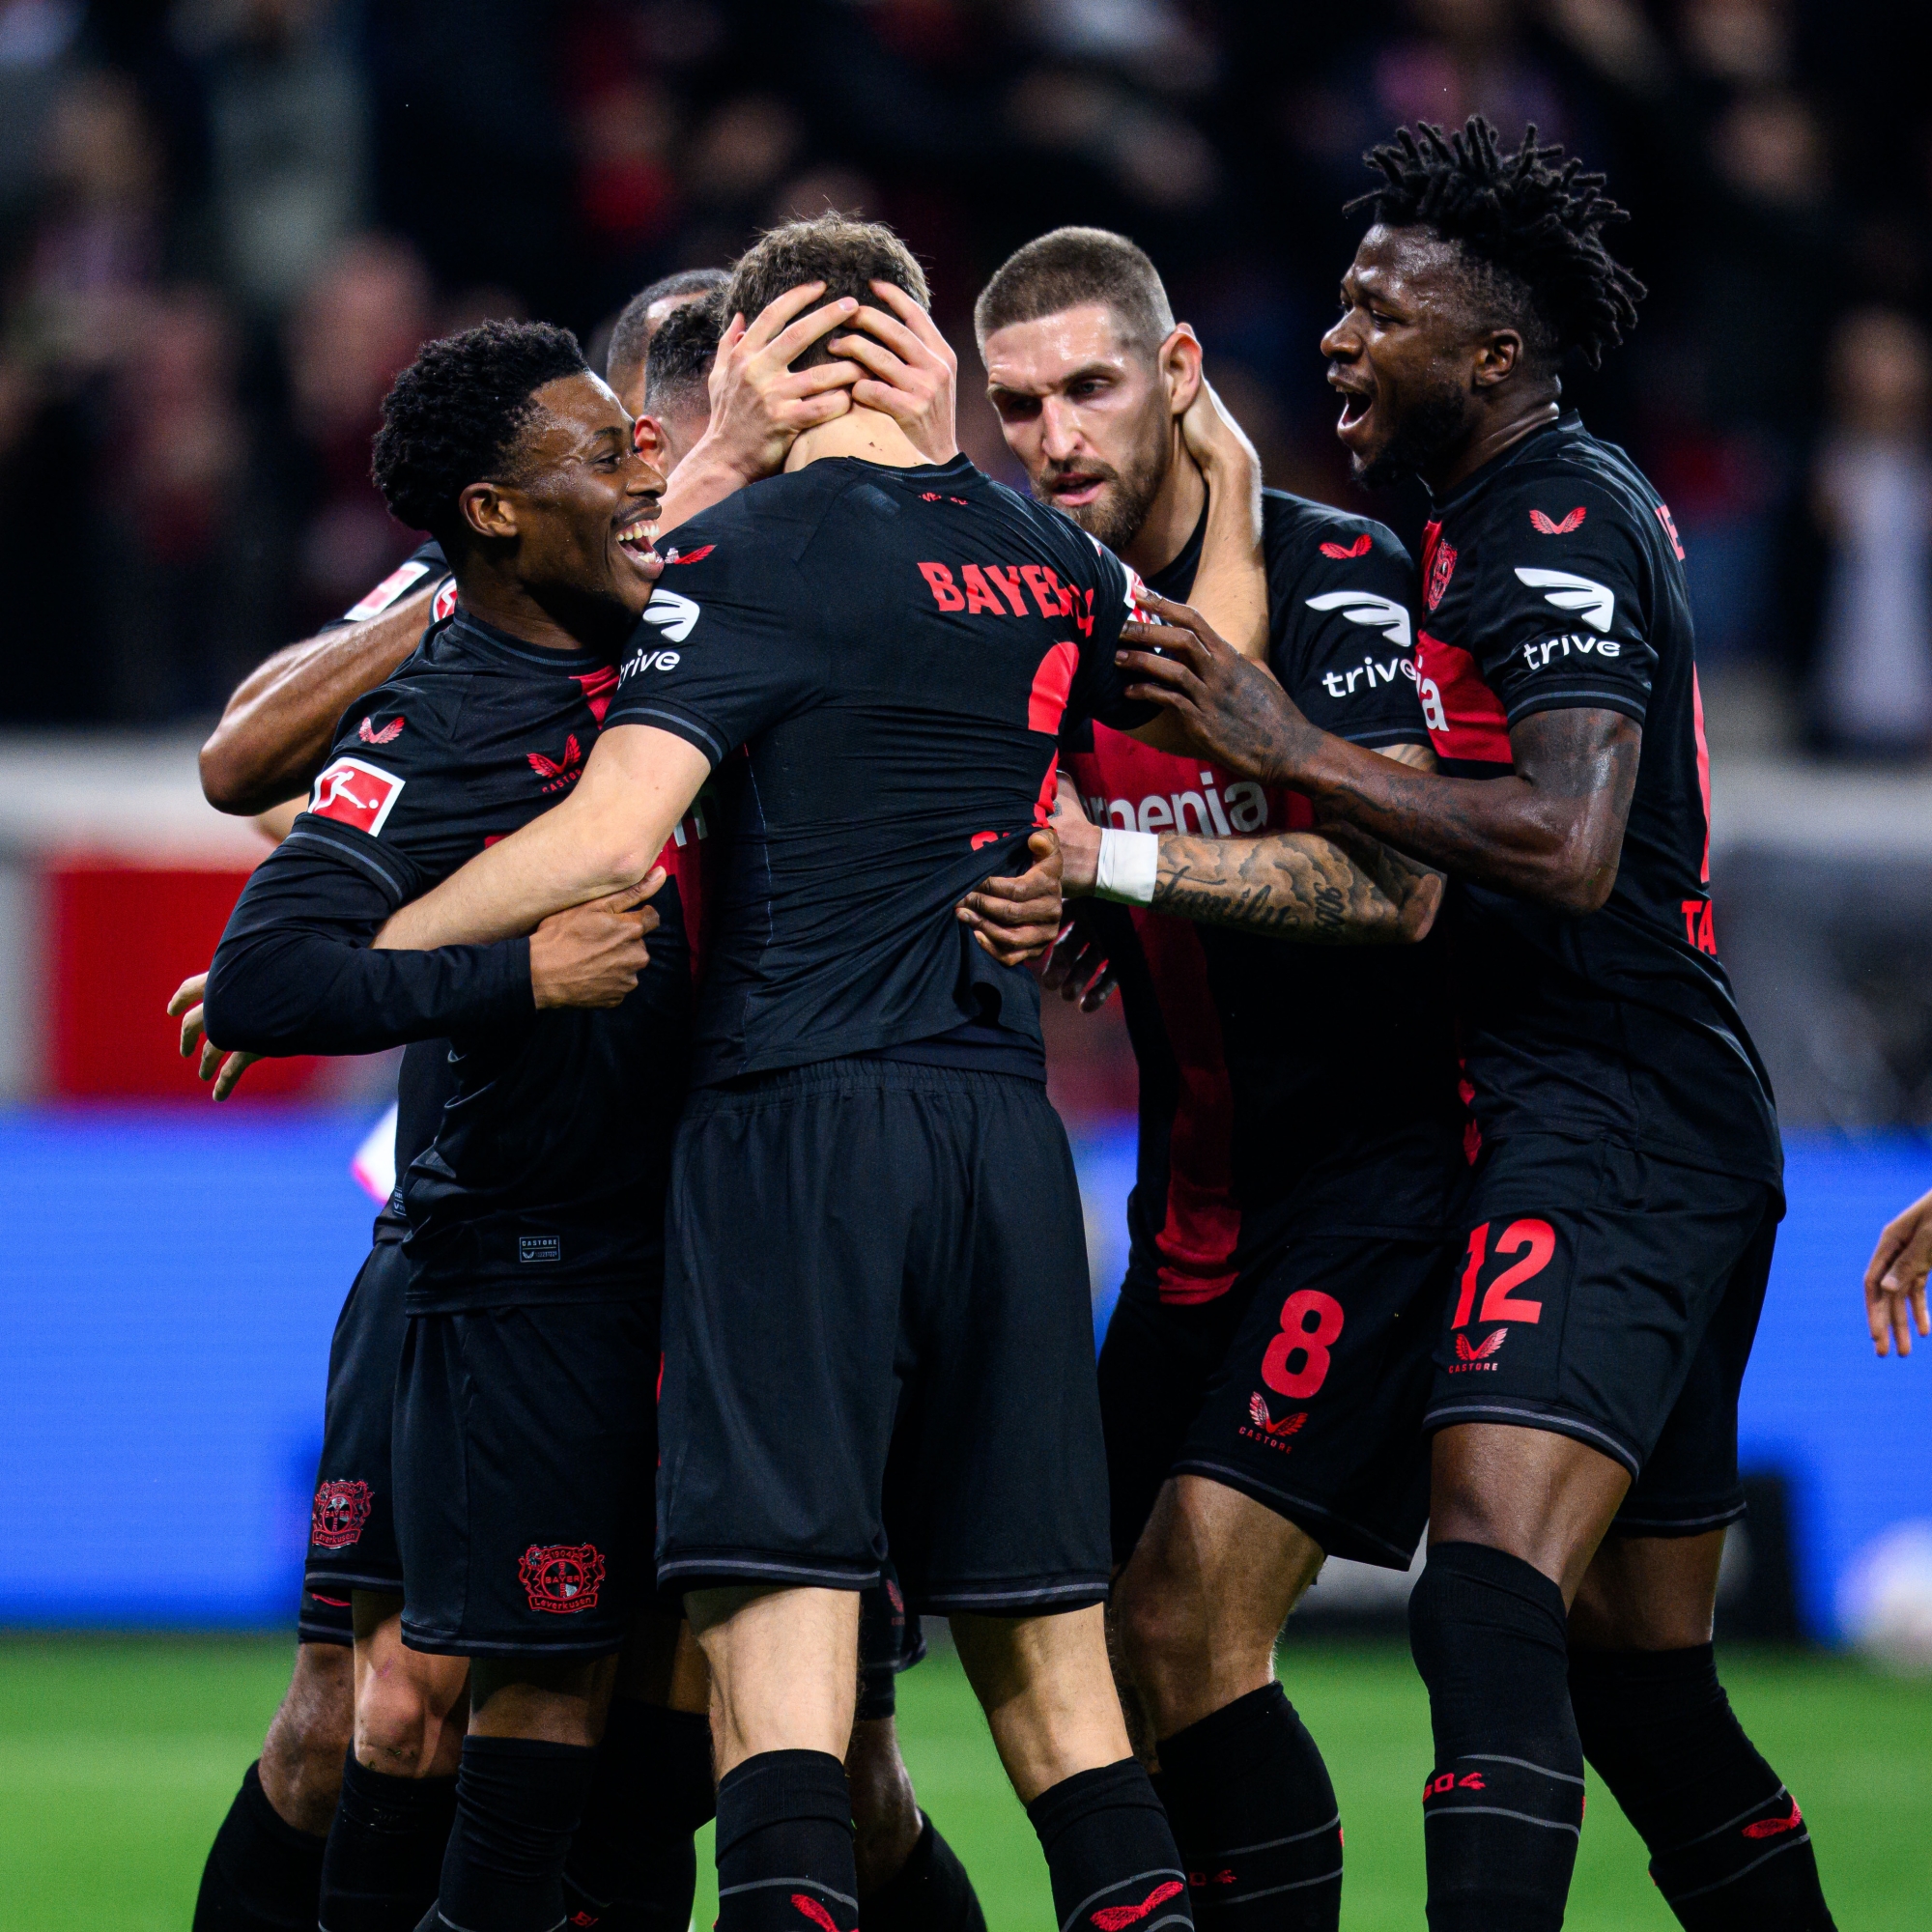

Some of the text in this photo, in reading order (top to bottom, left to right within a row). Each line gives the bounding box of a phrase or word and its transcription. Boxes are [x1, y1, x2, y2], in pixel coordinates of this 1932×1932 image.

[1523, 634, 1621, 670] trive
[1321, 657, 1416, 697] trive
[1451, 1218, 1556, 1330] 12
[1261, 1289, 1345, 1399] 8
[1448, 1362, 1498, 1375] CASTORE
[1238, 1426, 1293, 1455] CASTORE
[545, 1575, 580, 1584] BAYER
[534, 1597, 592, 1610] Leverkusen
